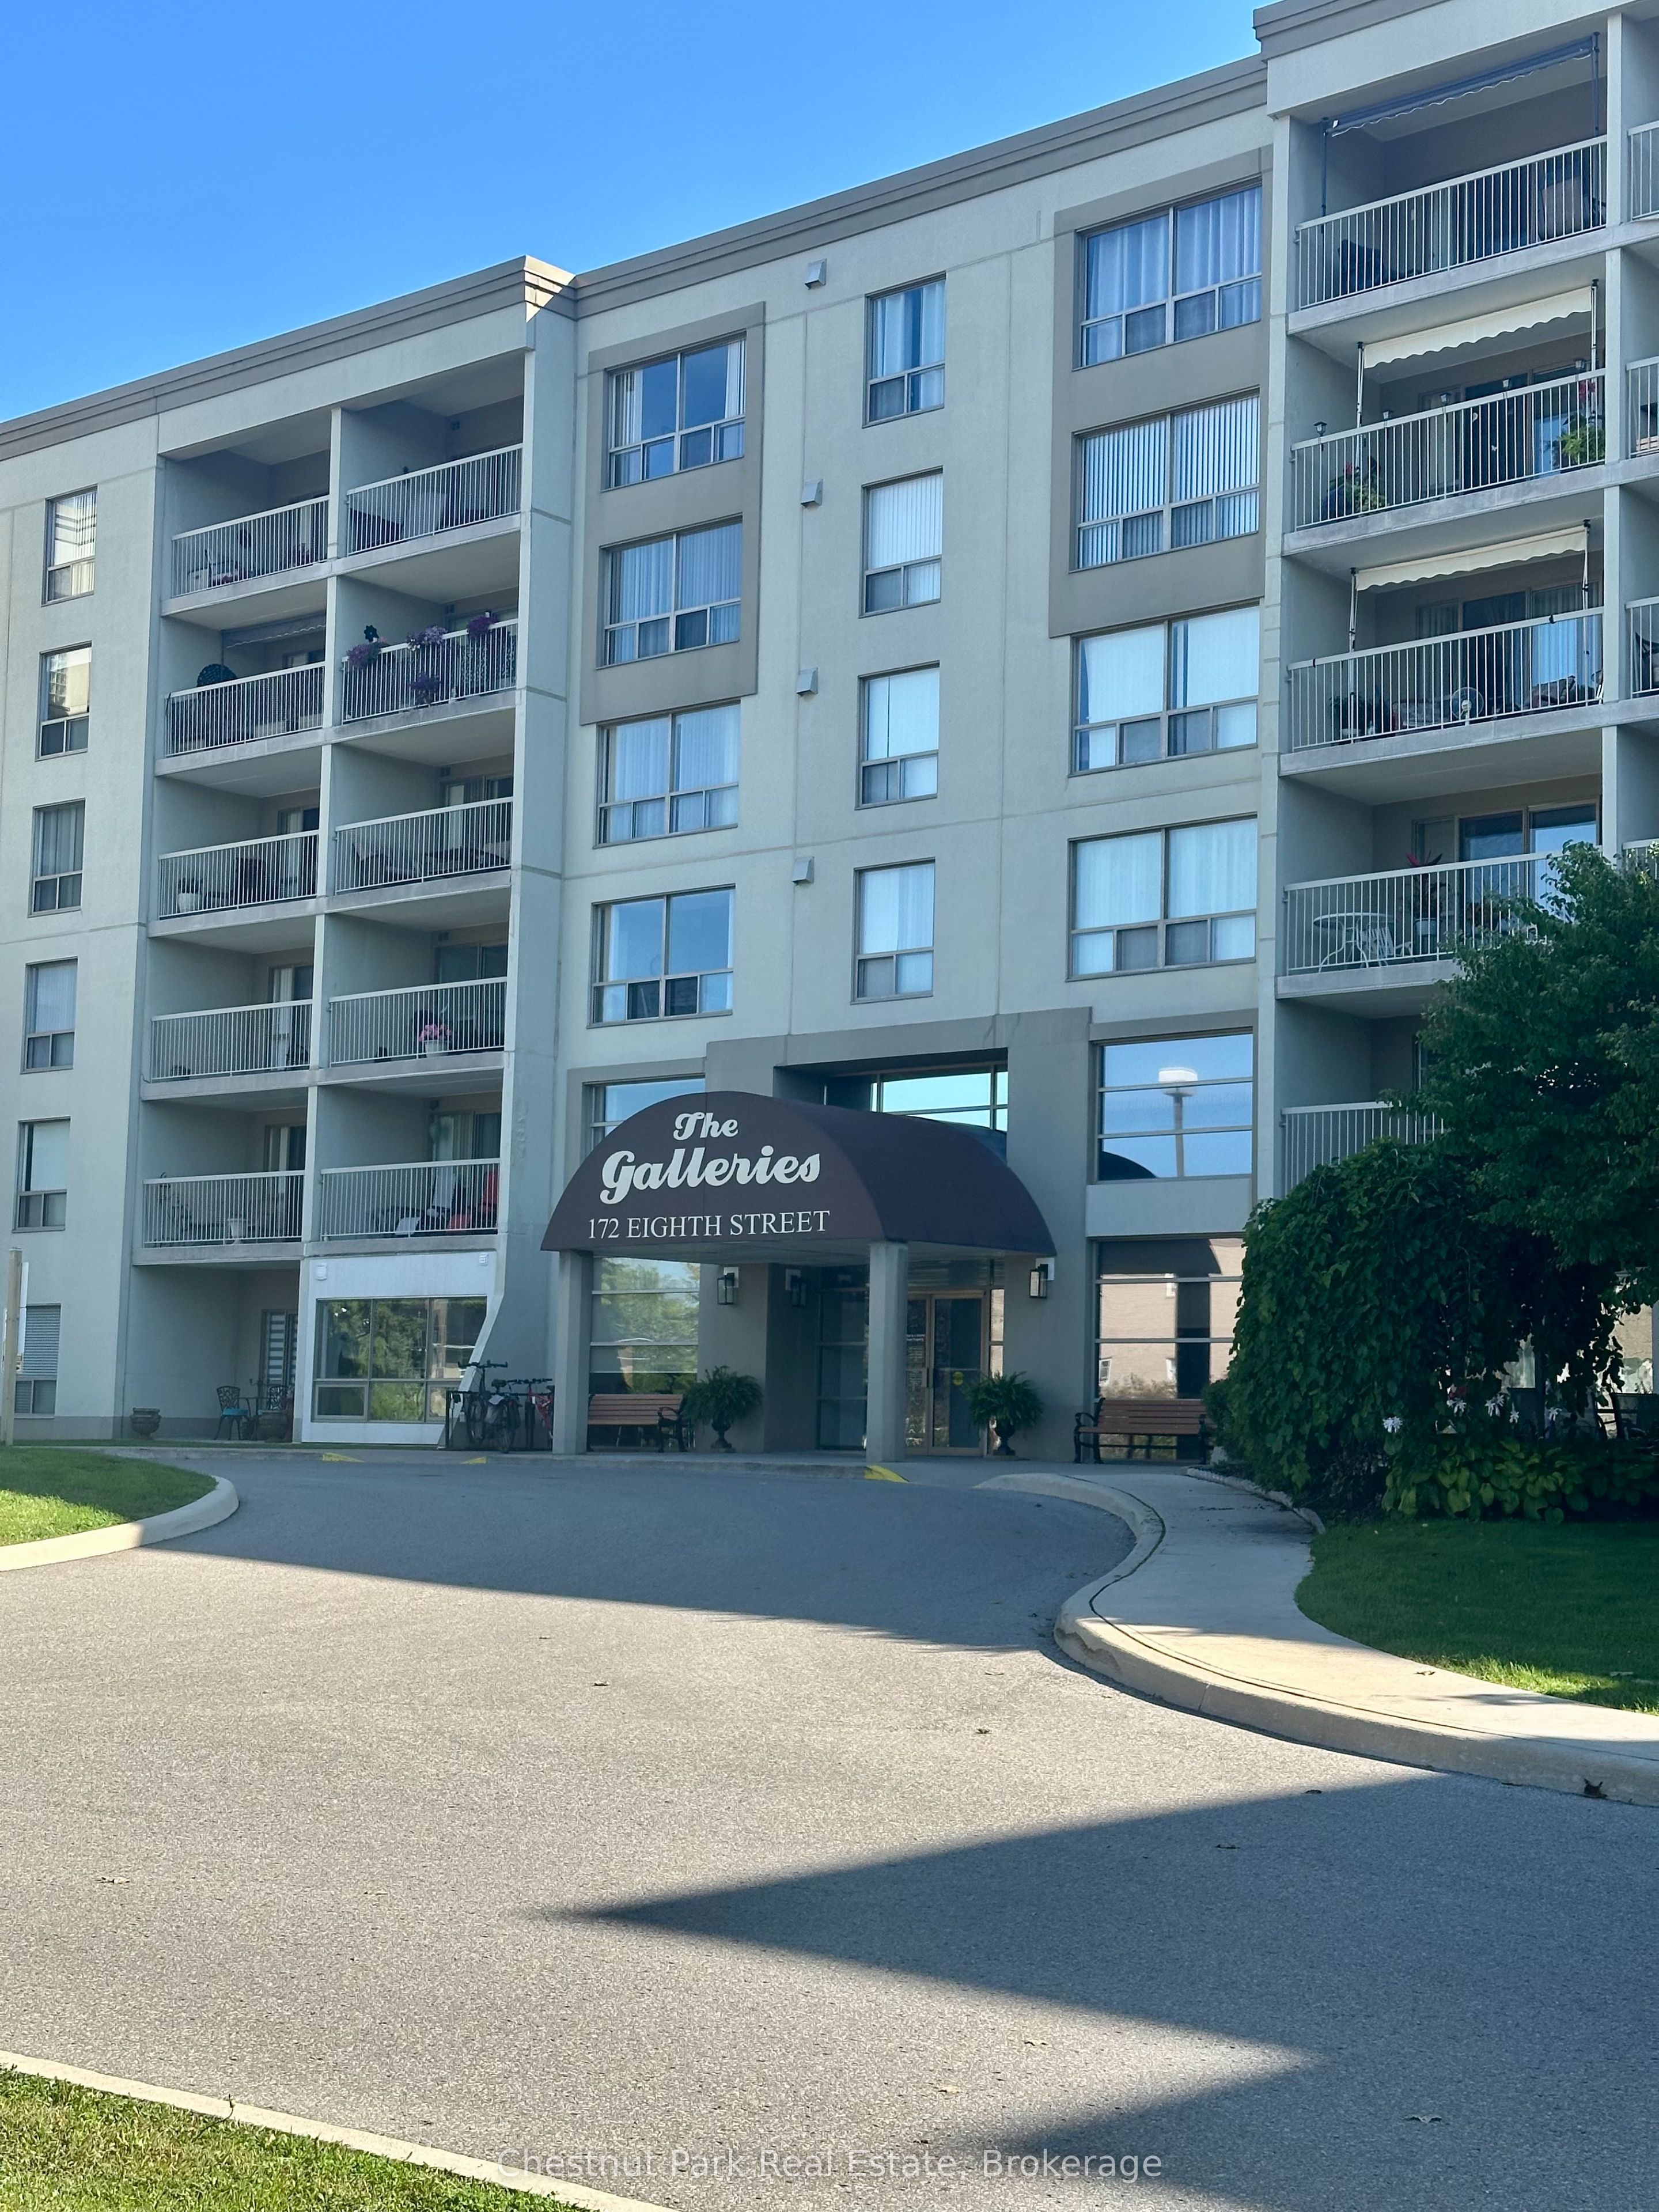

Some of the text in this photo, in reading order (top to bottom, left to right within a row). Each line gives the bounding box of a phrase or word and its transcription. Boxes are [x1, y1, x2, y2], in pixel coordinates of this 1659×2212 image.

[673, 1112, 738, 1141] The
[599, 1145, 820, 1205] Galleries
[588, 1210, 830, 1239] 172 EIGHTH STREET
